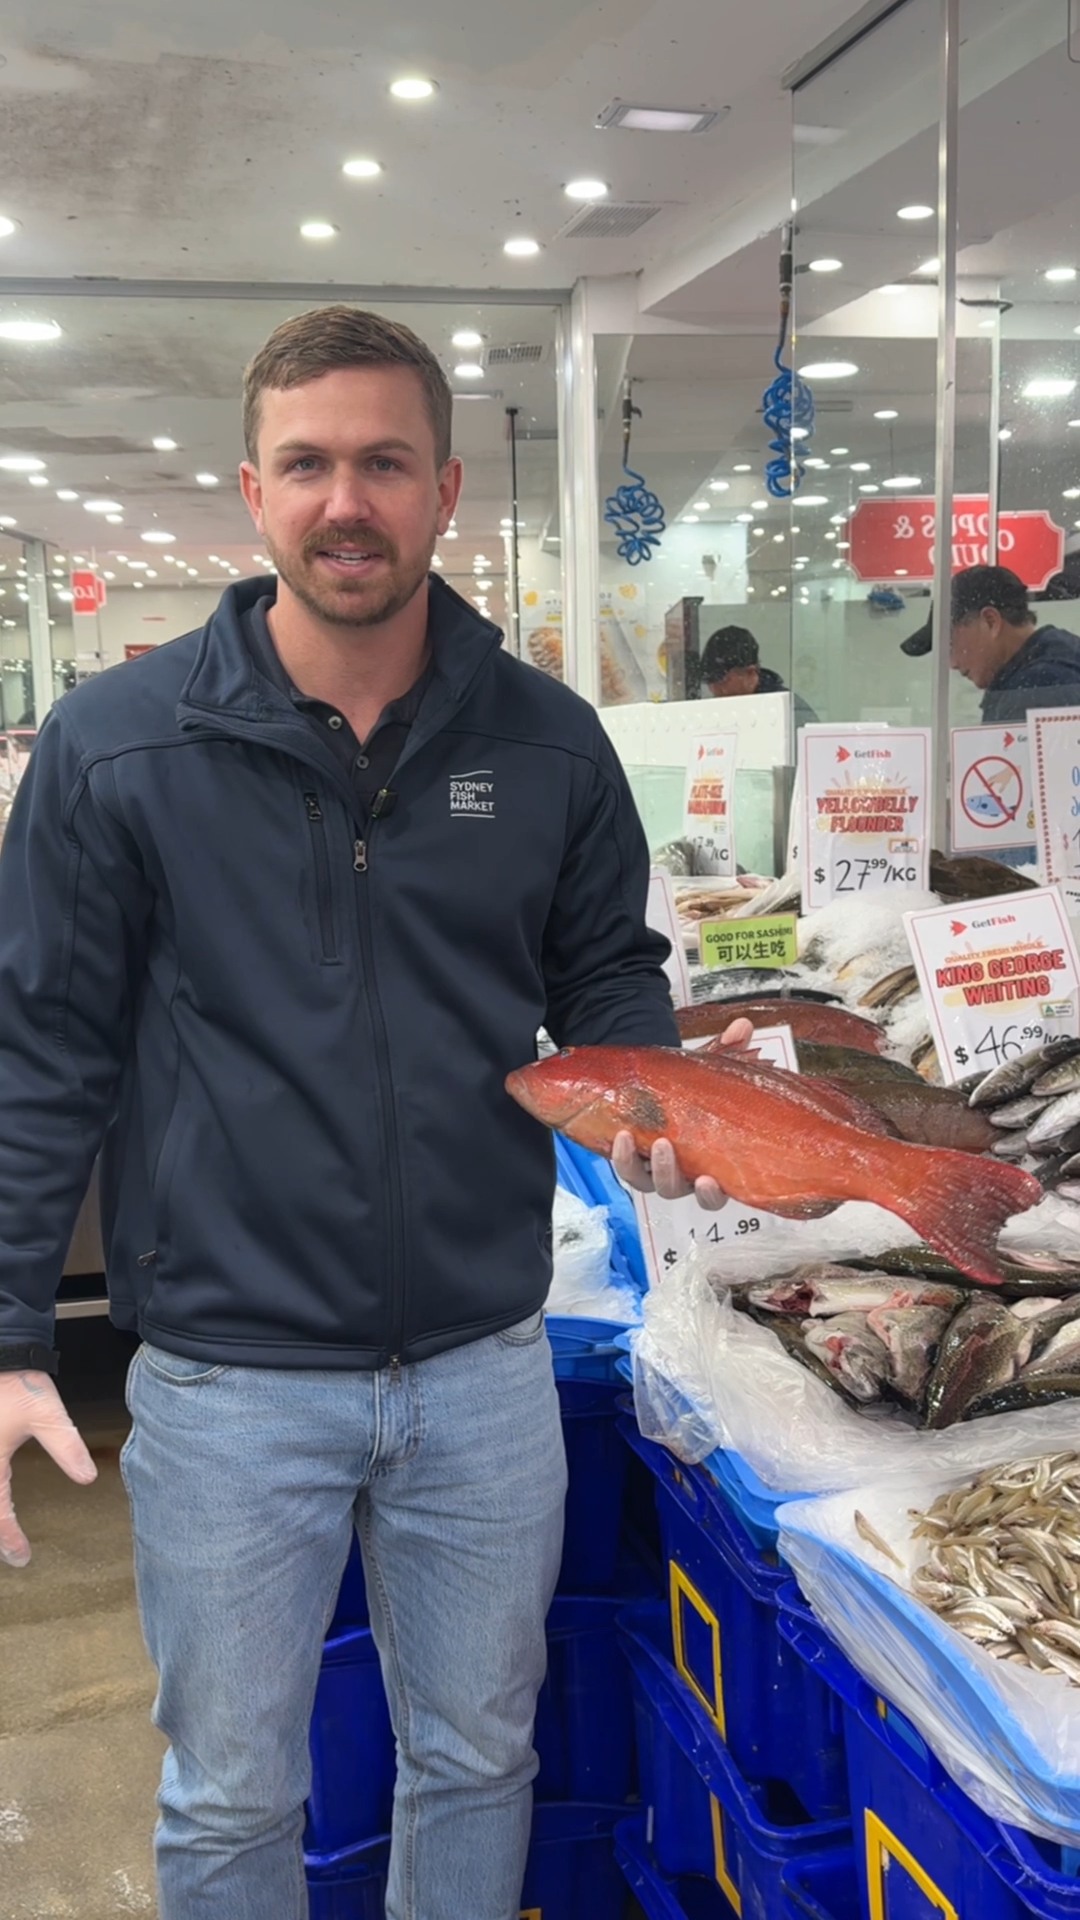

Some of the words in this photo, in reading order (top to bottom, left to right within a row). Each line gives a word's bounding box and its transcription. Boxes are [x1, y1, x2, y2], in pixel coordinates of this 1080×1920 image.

[854, 749, 892, 759] GetFish
[450, 781, 494, 792] SYDNEY
[450, 791, 475, 801] FISH
[450, 800, 495, 811] MARKET
[830, 815, 904, 833] FLOUNDER
[814, 867, 826, 884] $
[972, 915, 1016, 929] GetFish
[706, 932, 734, 943] GOOD
[735, 930, 755, 940] FOR
[756, 927, 793, 938] SASHIMI
[717, 940, 786, 962] 可以生吃
[944, 953, 980, 964] QUALITY
[936, 962, 984, 988] KING
[988, 948, 1066, 979] GEORGE
[963, 975, 1050, 1007] WHITING
[954, 1046, 969, 1066] $
